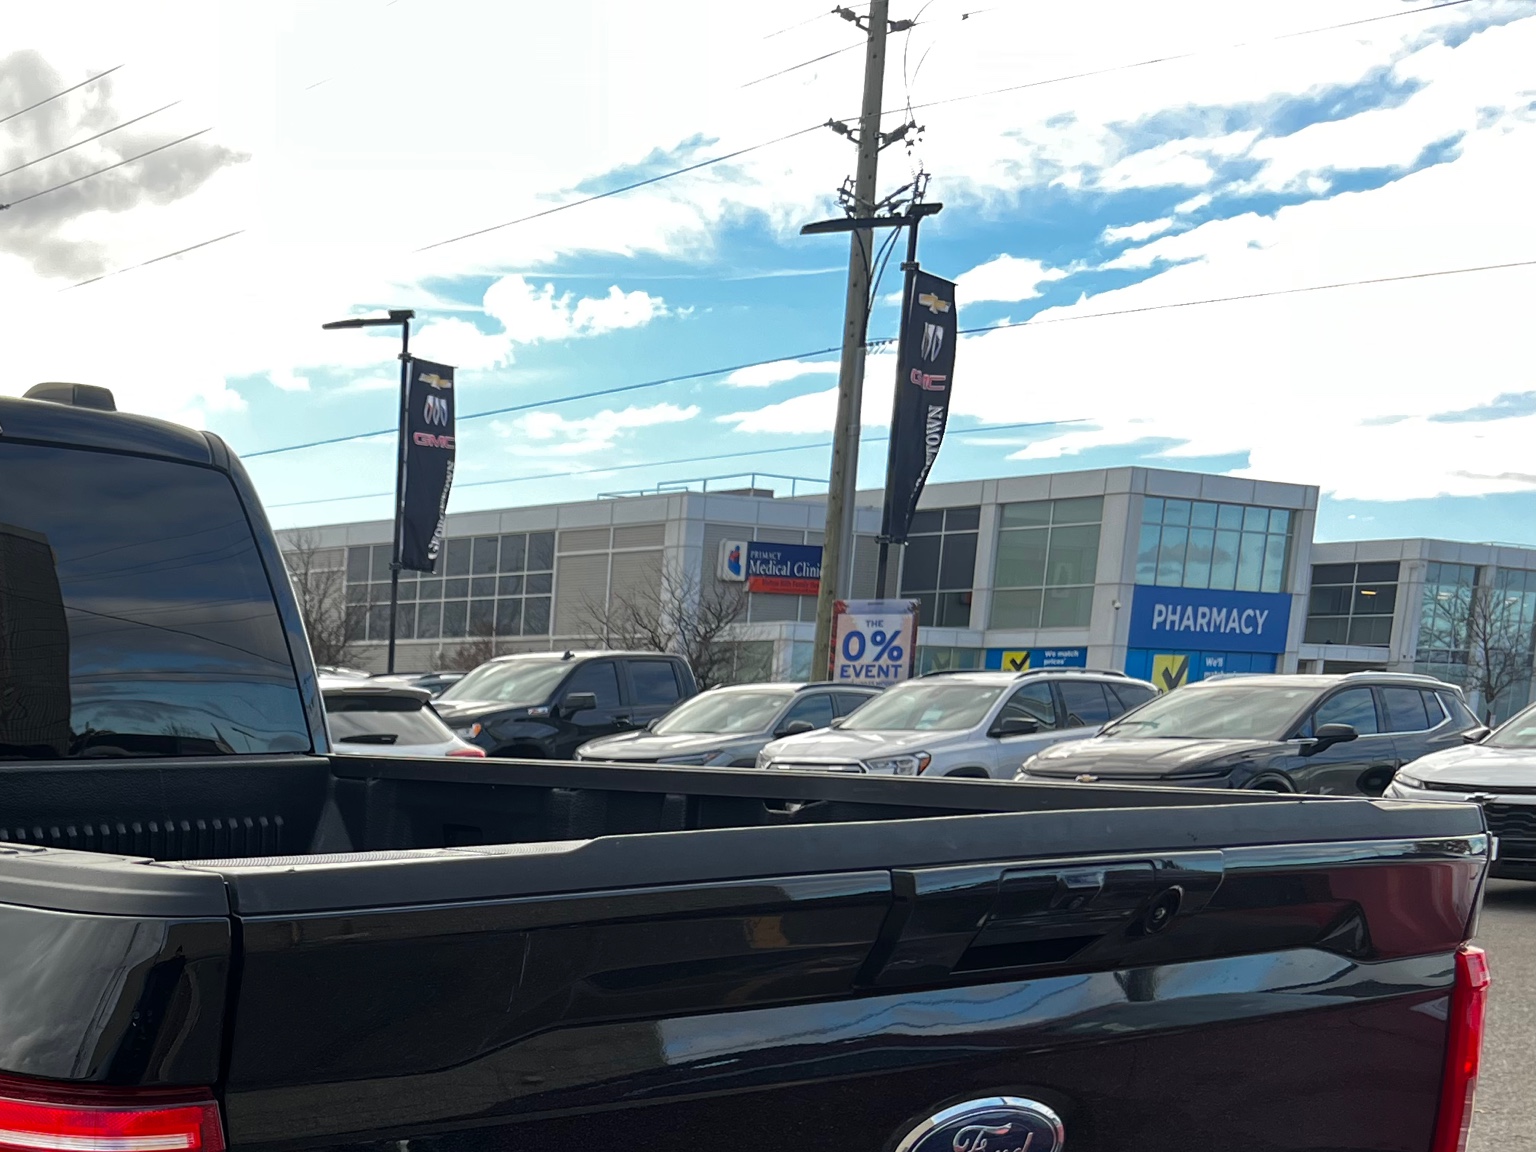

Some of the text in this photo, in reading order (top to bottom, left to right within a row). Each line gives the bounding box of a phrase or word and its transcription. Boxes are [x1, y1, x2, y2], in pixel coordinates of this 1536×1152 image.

[413, 432, 455, 450] GMC
[749, 560, 823, 578] Medical Clini
[865, 619, 884, 628] THE
[1151, 603, 1269, 635] PHARMACY
[842, 629, 903, 662] 0%
[840, 664, 903, 679] EVENT
